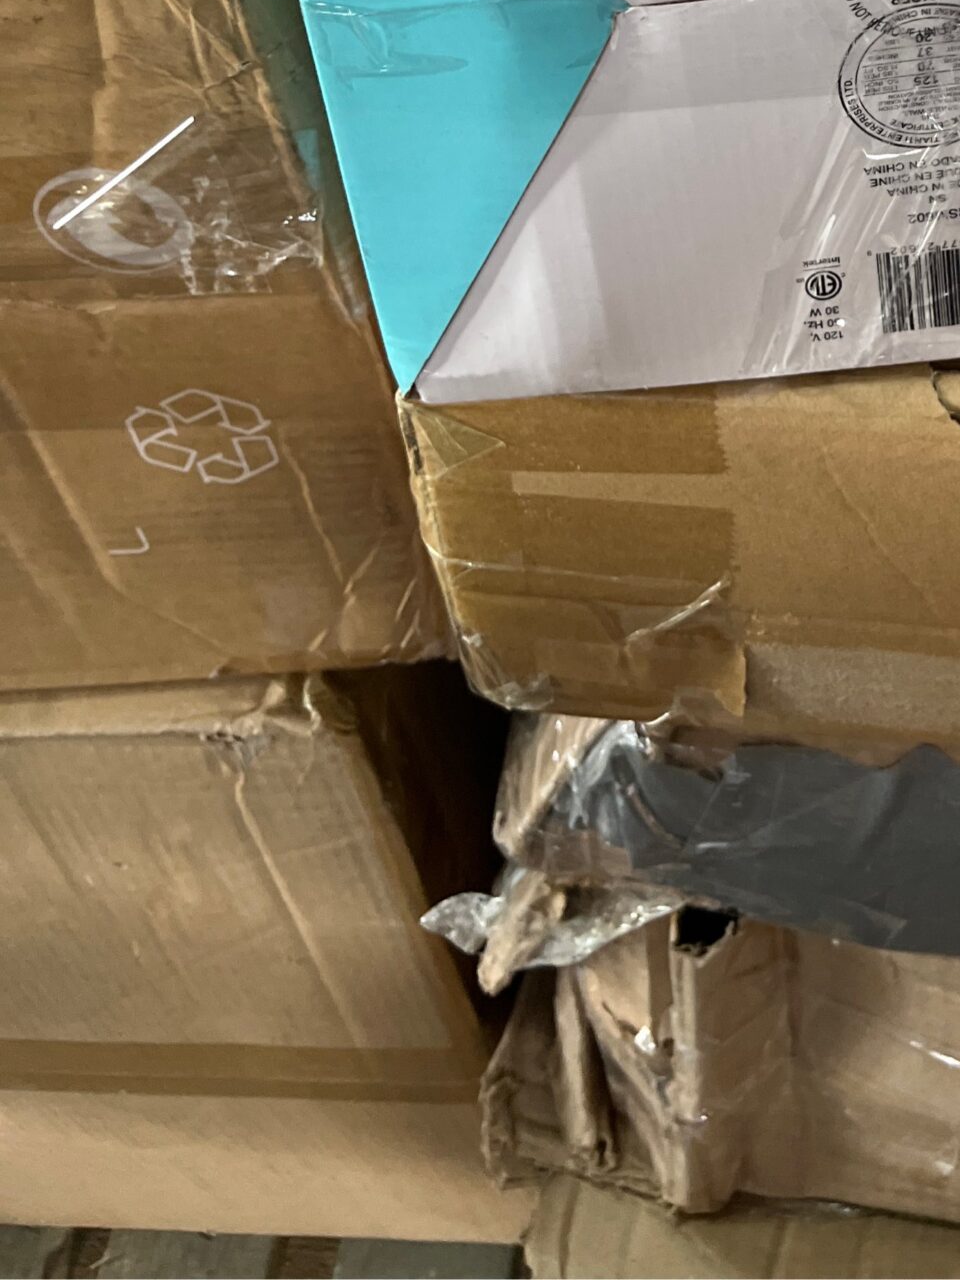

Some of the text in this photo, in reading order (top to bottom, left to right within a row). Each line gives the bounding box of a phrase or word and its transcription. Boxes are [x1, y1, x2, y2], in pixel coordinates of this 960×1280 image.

[850, 1, 872, 21] NOT
[917, 46, 934, 57] 37
[913, 75, 939, 86] 125
[847, 96, 903, 144] ENTERPRISES
[863, 162, 905, 176] CHINA
[869, 174, 911, 188] CHINE
[915, 171, 932, 182] EN
[887, 184, 929, 197] CHINA
[802, 256, 841, 268] Intertek
[809, 274, 838, 297] ETL
[809, 305, 840, 317] 30 W
[823, 330, 844, 341] 120
